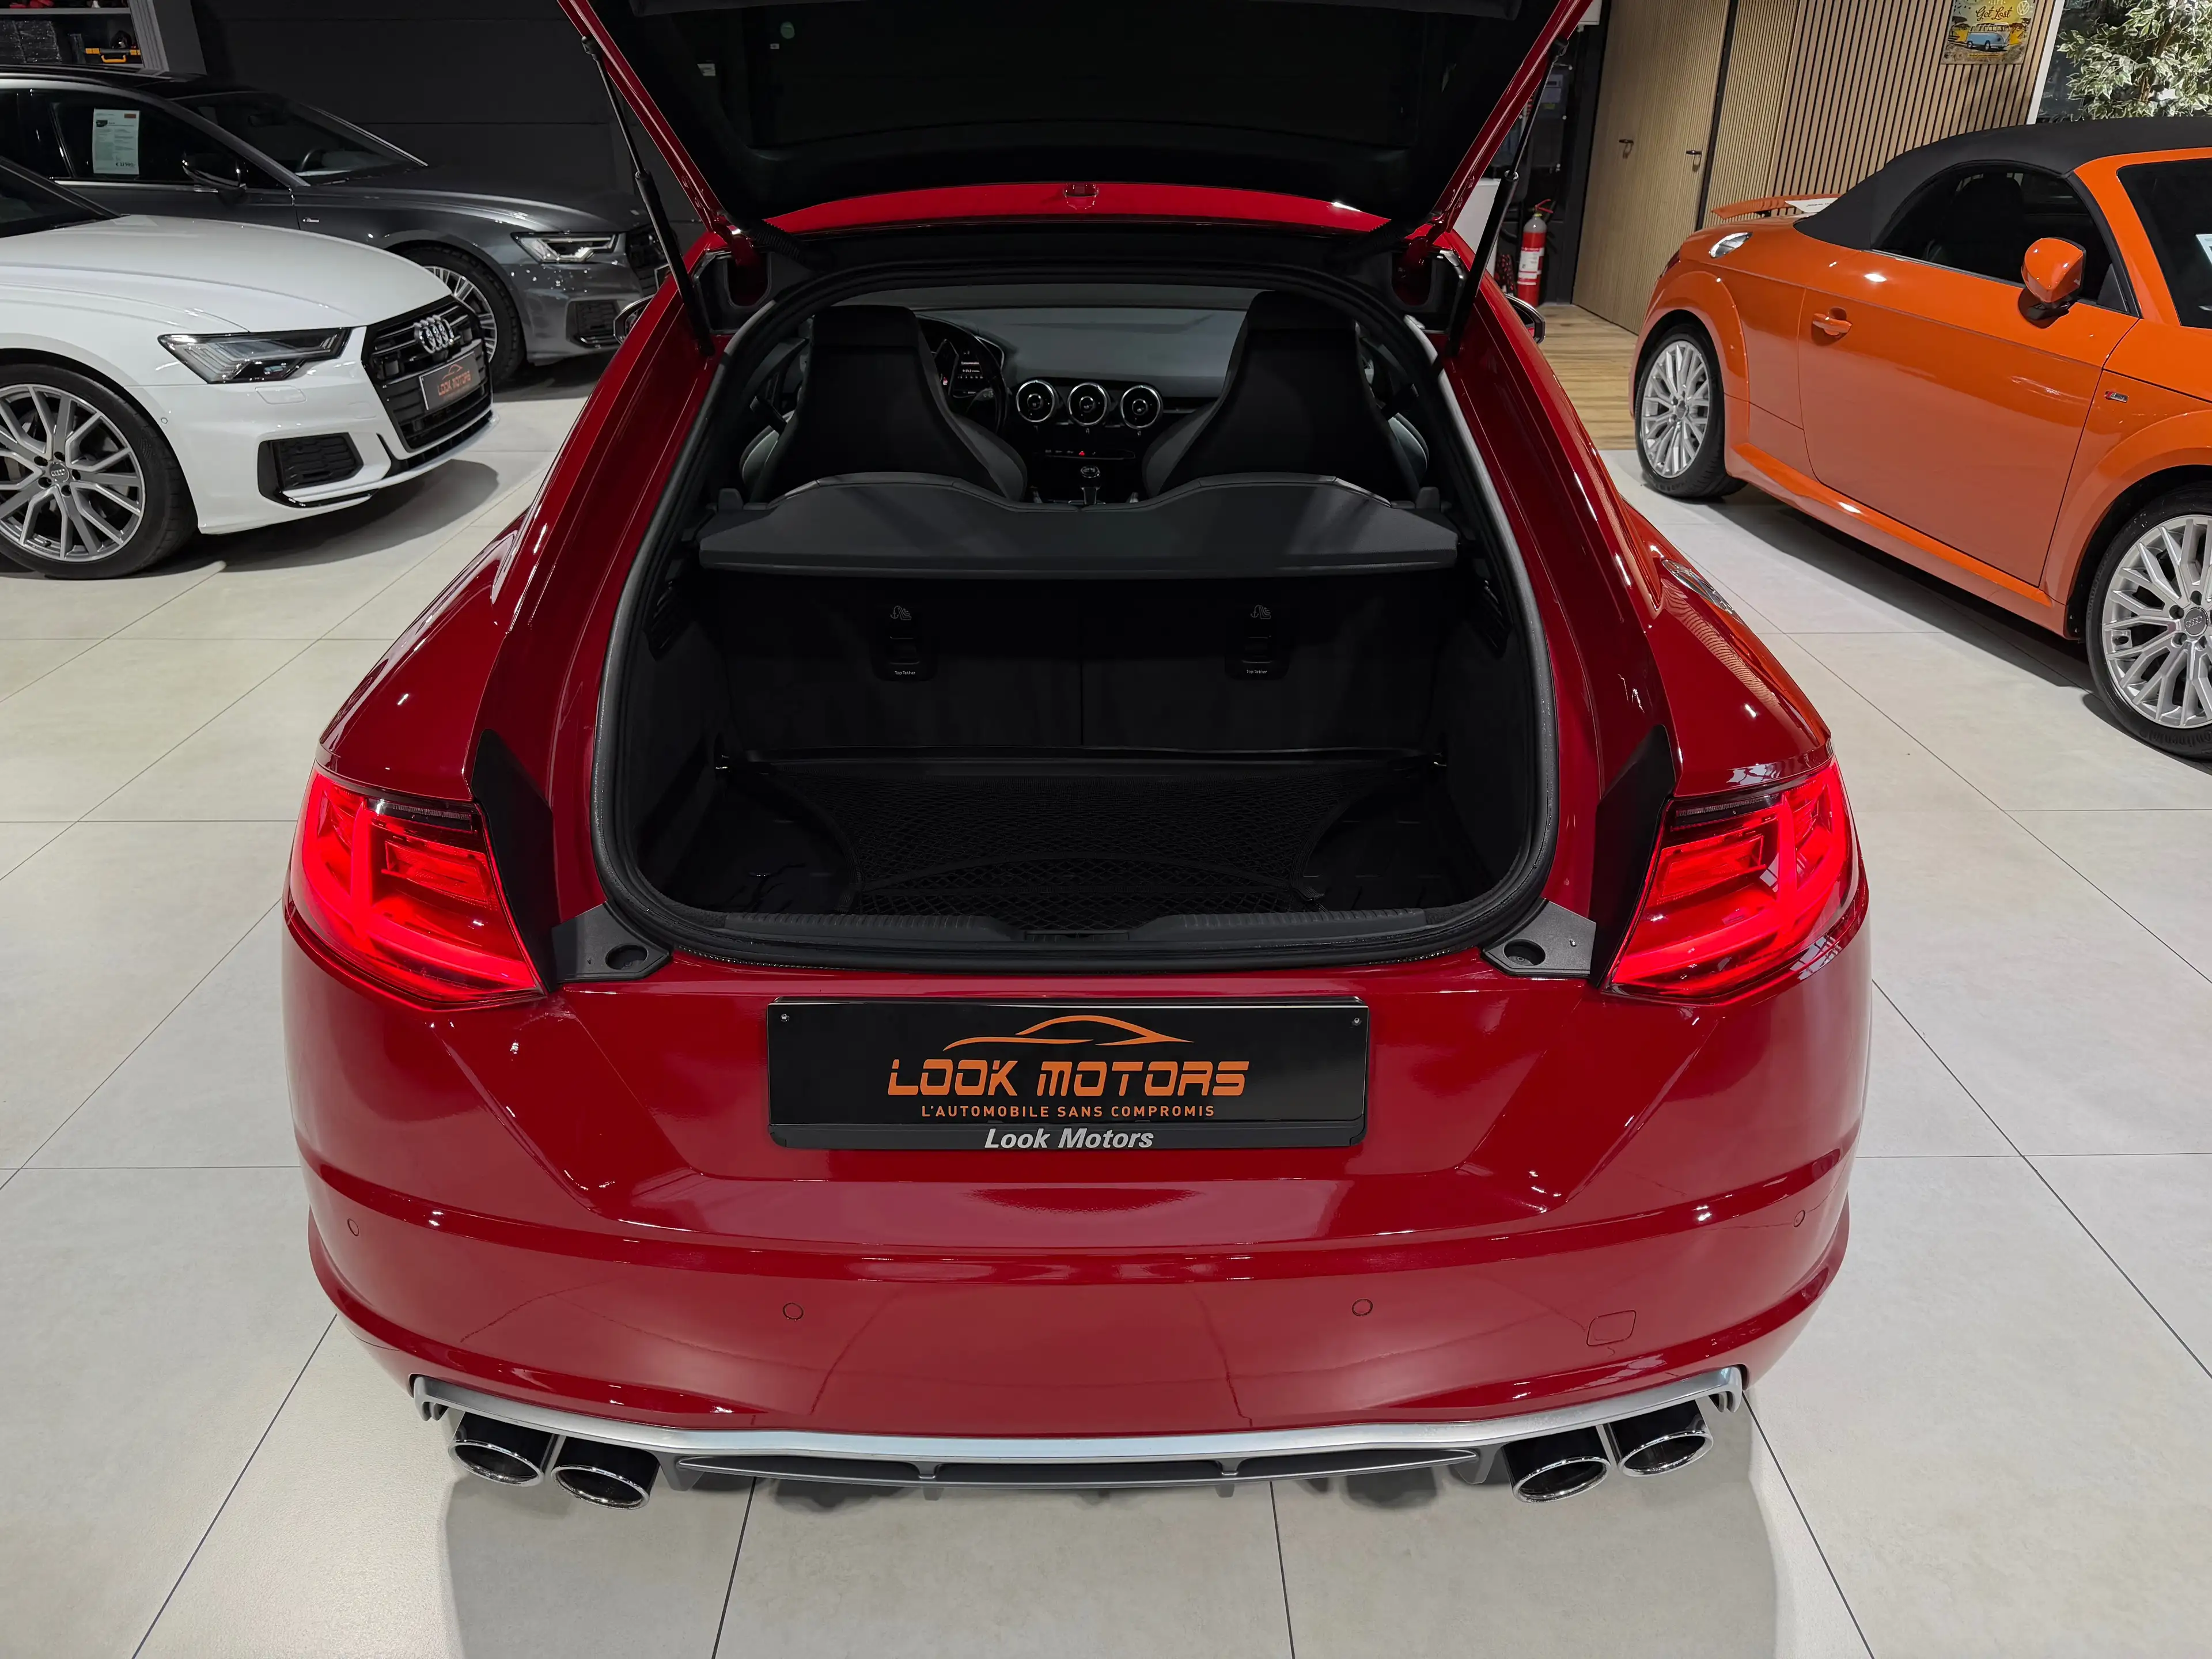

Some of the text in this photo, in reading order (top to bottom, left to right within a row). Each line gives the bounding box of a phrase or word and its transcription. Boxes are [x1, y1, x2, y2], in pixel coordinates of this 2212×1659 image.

[1976, 6, 2013, 21] Get Lost
[888, 1059, 1249, 1096] LOOK MOTORS
[922, 1105, 1214, 1118] L'AUTOMOBILE SANS COMPROMIS
[984, 1128, 1154, 1149] Look Motors
